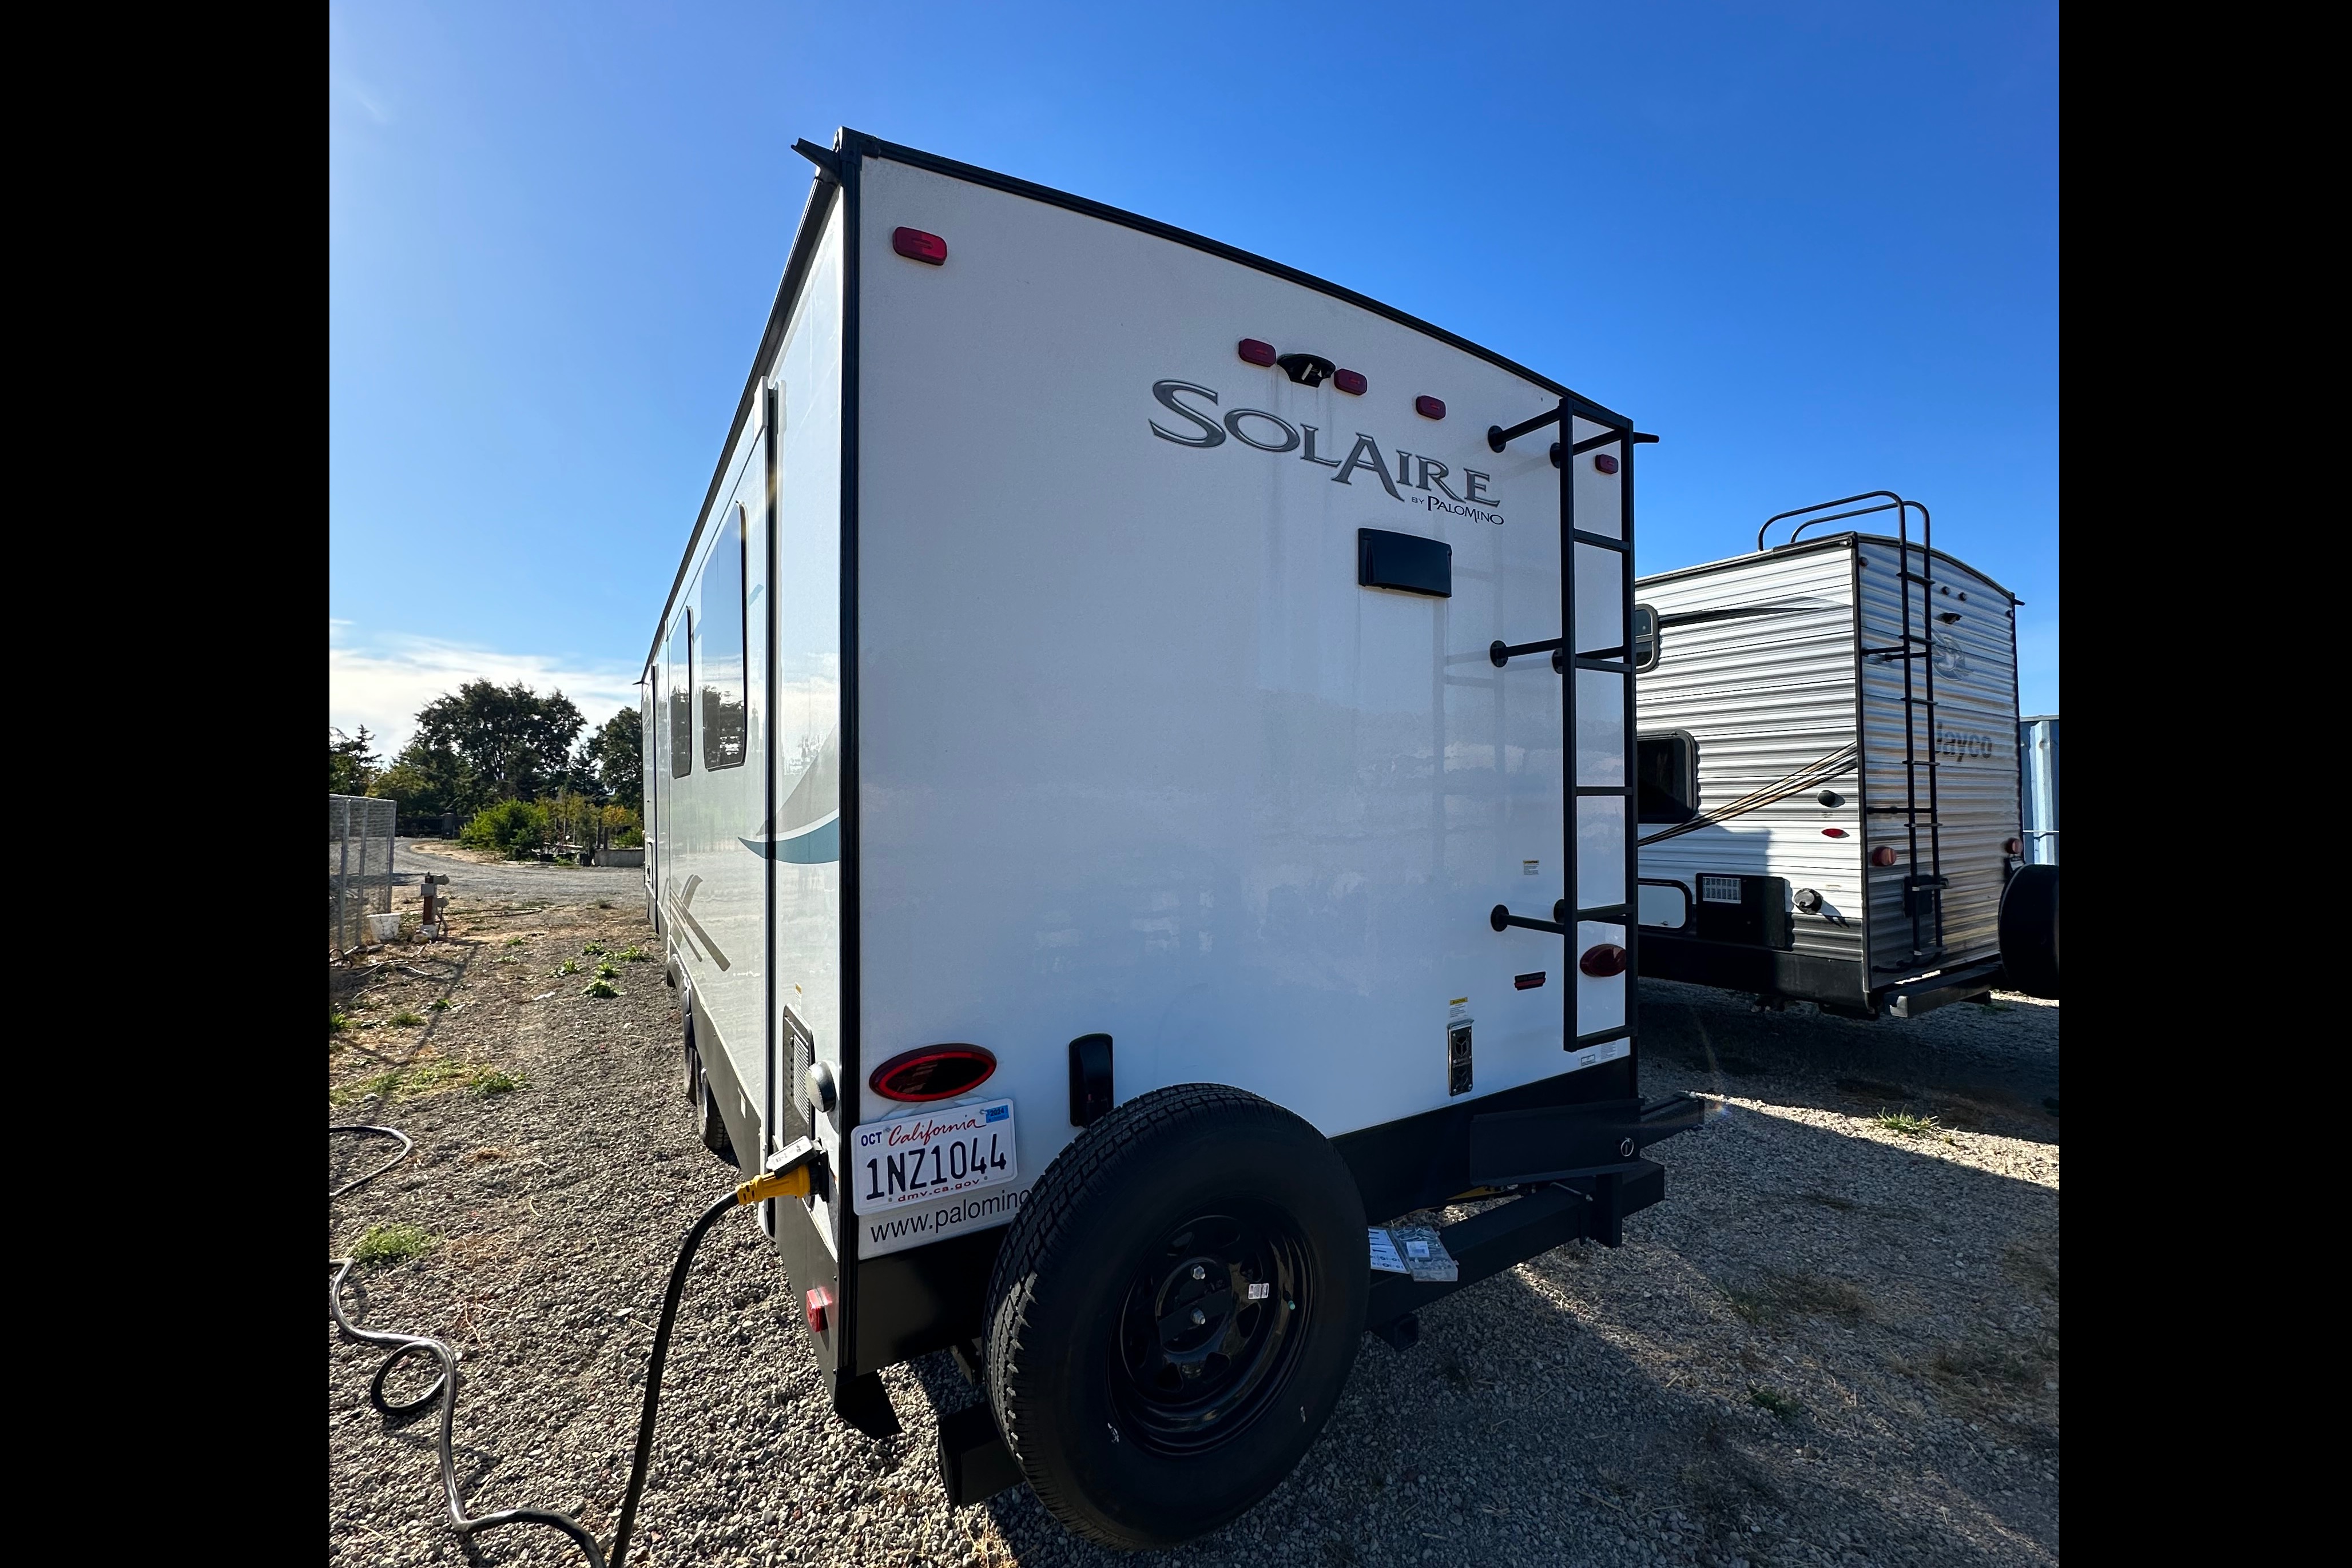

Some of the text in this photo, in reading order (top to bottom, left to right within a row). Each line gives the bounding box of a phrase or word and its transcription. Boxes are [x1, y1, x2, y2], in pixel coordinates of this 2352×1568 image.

[1411, 495, 1504, 525] BY PALOMINO
[990, 1107, 1004, 1117] 2024
[861, 1117, 987, 1147] OCT California
[866, 1133, 1007, 1200] 1NZ1044
[898, 1179, 979, 1202] dmv.ca.gov
